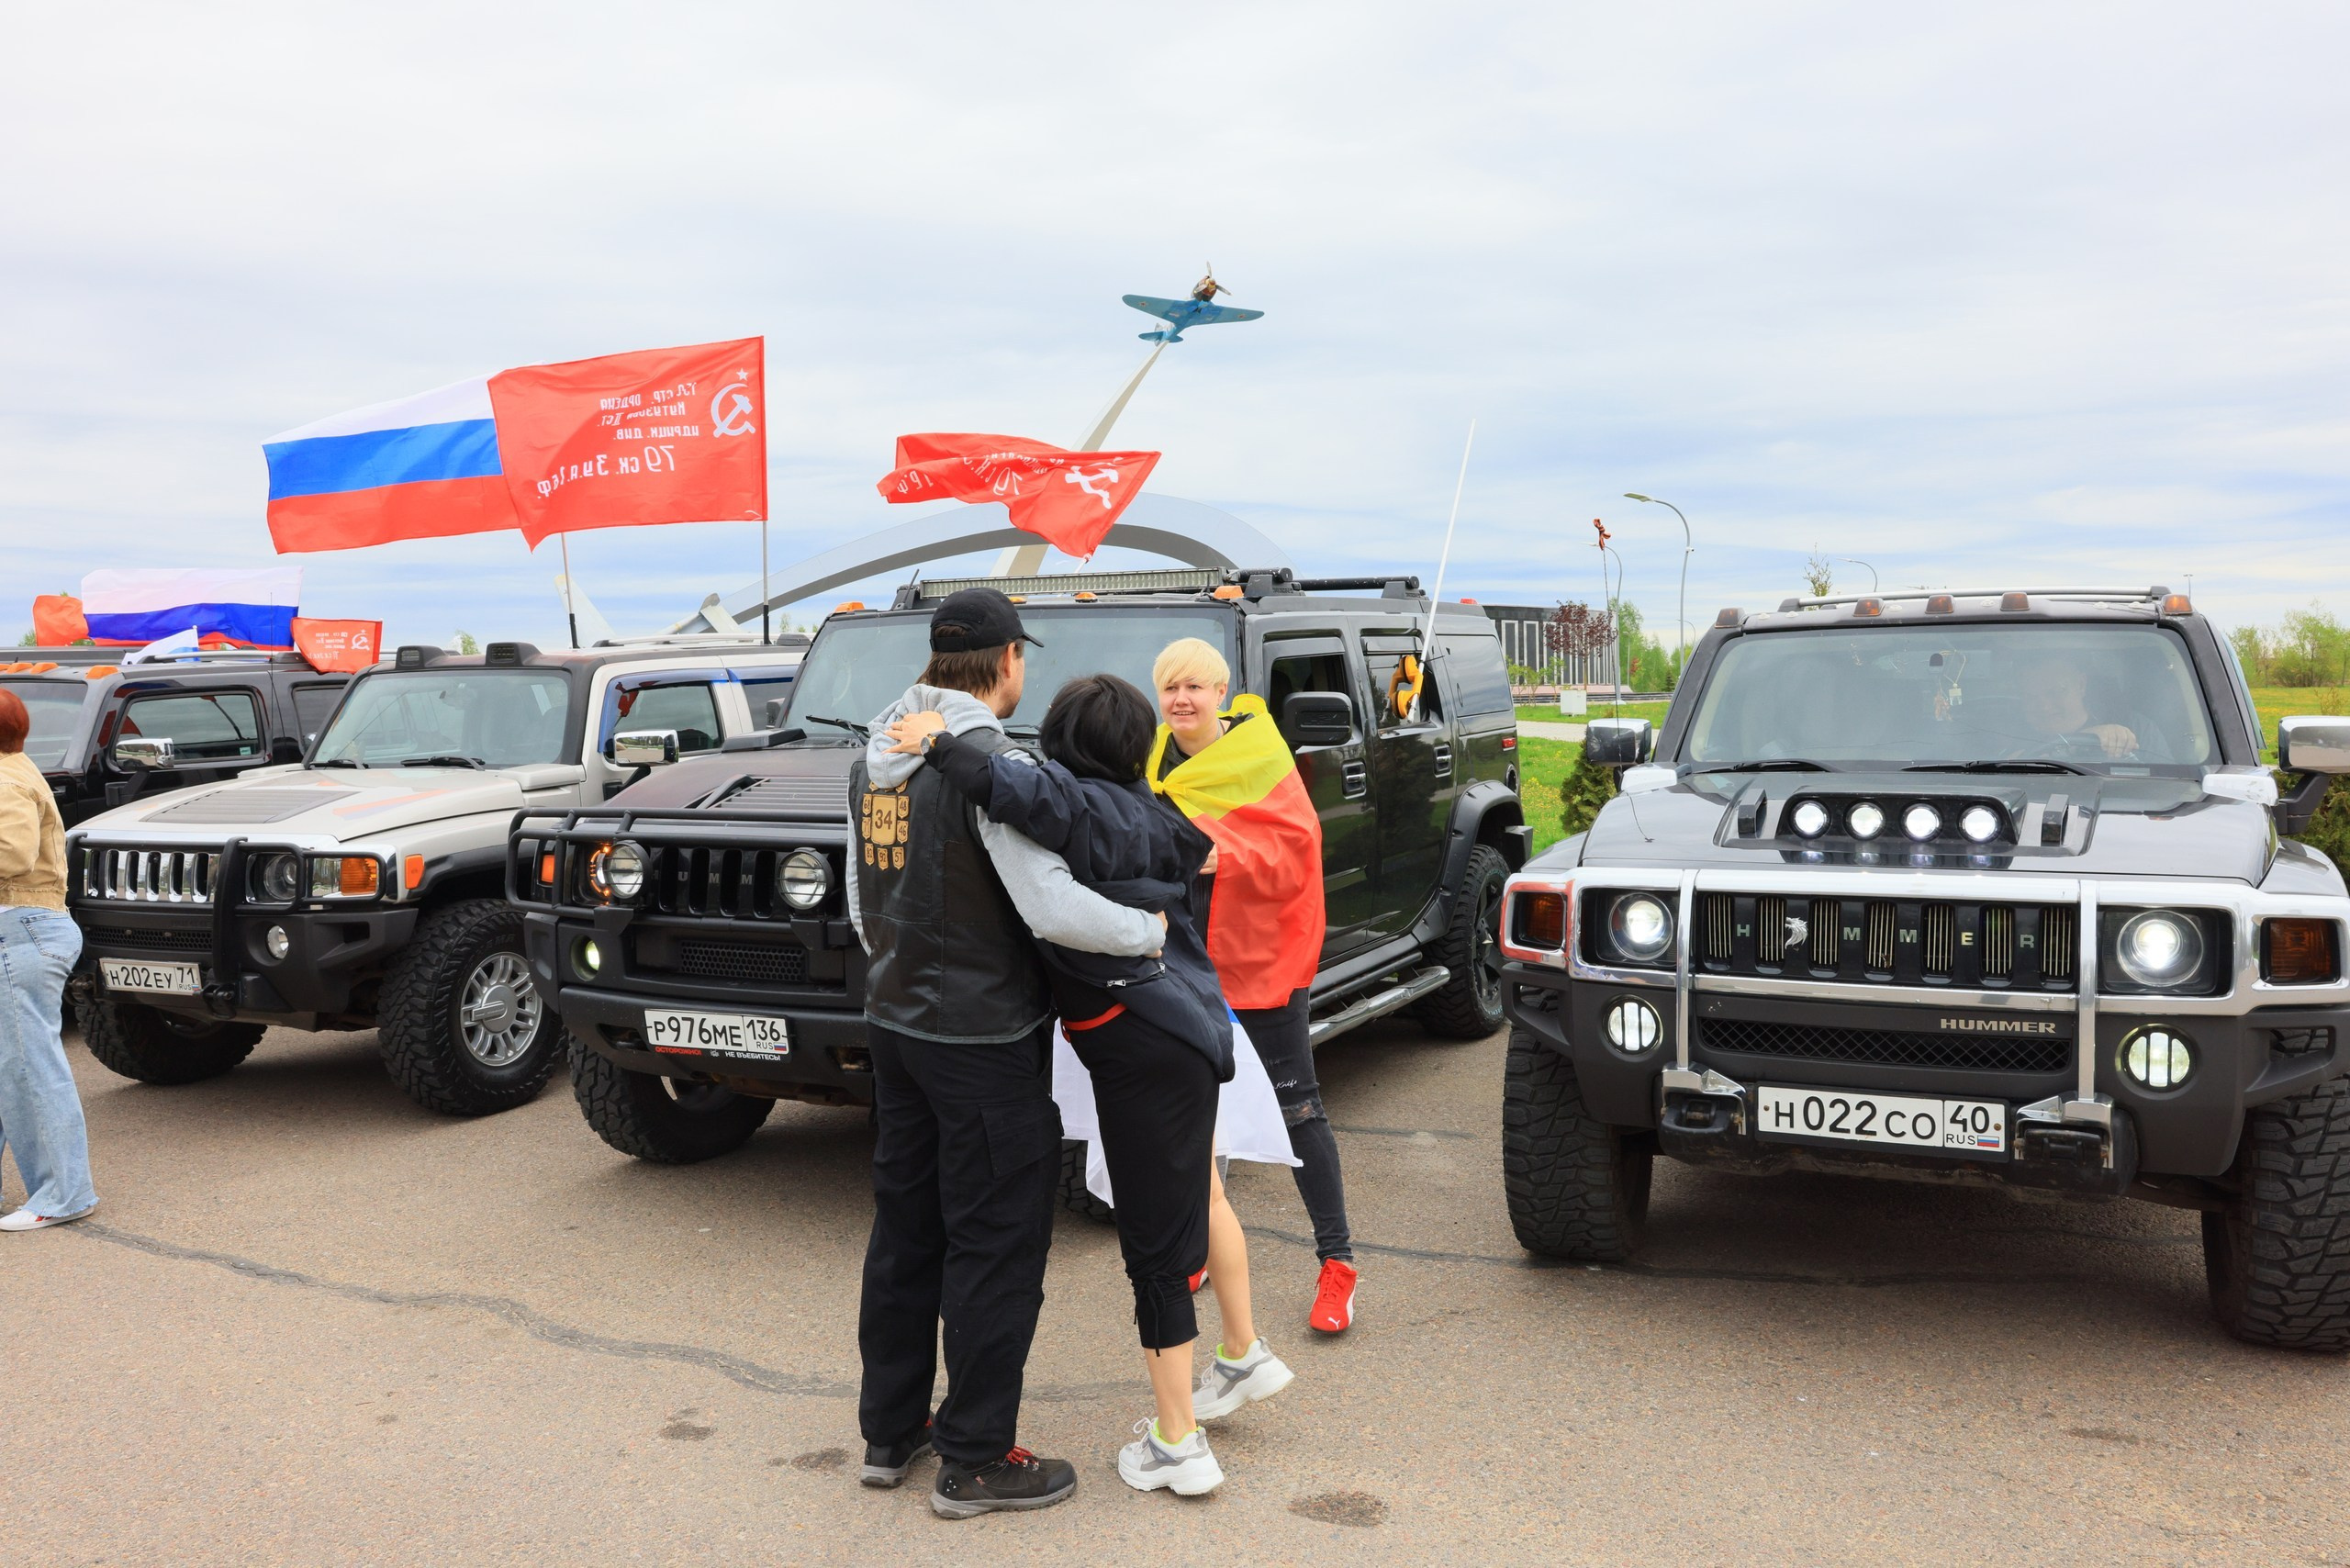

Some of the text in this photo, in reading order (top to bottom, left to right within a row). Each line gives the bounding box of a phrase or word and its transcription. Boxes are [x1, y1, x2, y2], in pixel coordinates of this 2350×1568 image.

[875, 809, 893, 830] 34
[899, 825, 907, 836] 46
[109, 966, 196, 989] Н202ЕУ 71
[654, 1015, 781, 1047] Р976МЕ 136
[1940, 1017, 2057, 1036] HUMMER
[755, 1041, 774, 1050] RUS
[1774, 1095, 1990, 1140] Н022СО 40
[1945, 1133, 1975, 1146] RUS
